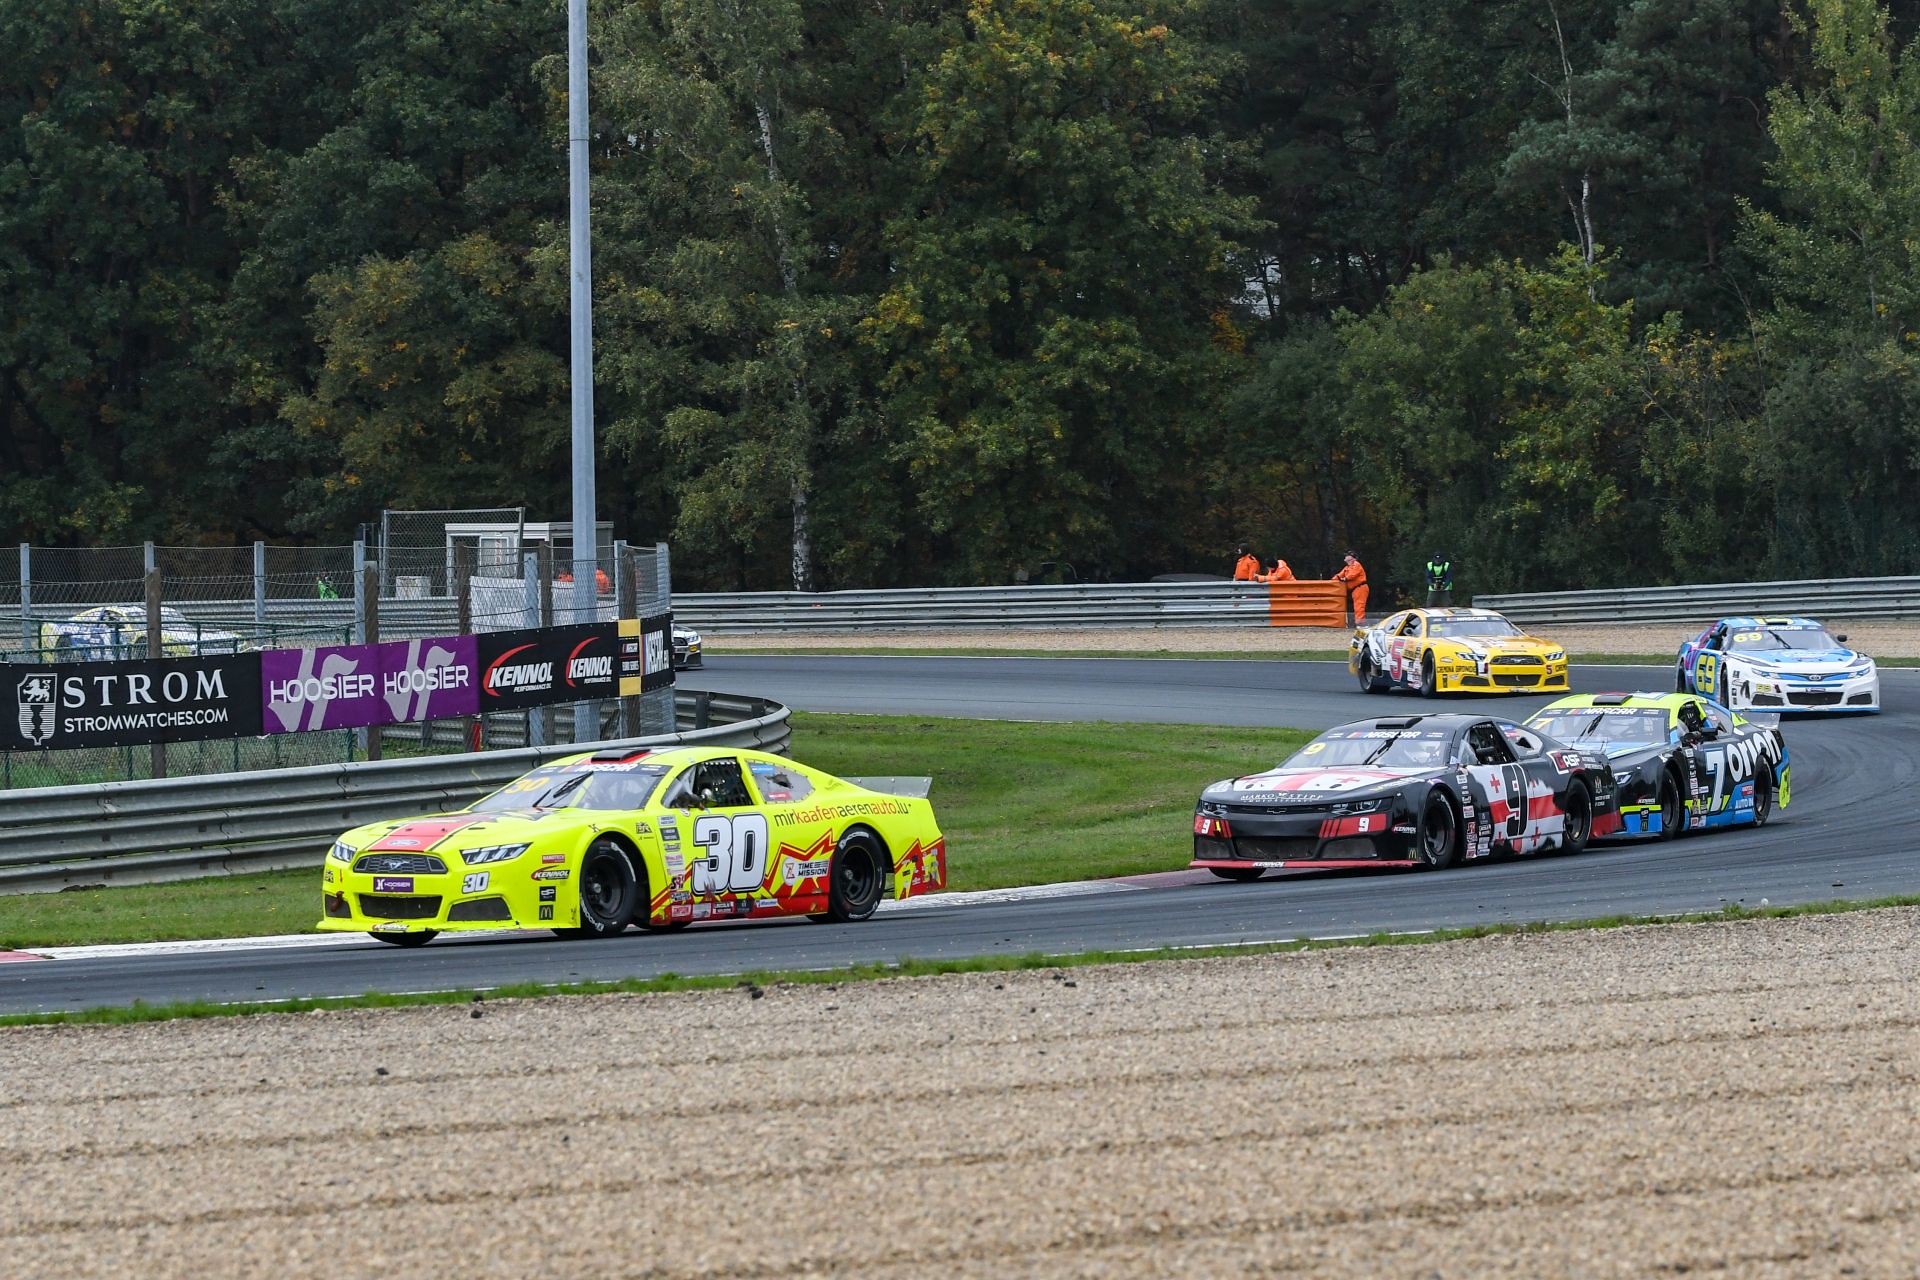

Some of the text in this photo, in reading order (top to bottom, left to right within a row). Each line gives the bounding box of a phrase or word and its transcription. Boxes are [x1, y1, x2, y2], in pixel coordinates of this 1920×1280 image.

[1733, 632, 1762, 642] 69
[567, 656, 612, 678] KENNOL
[1391, 638, 1405, 682] 5
[1546, 665, 1552, 674] 5
[384, 665, 469, 695] HOOSIER
[488, 662, 553, 688] KENNOL
[1696, 654, 1716, 694] 69
[63, 669, 228, 708] STROM
[270, 674, 375, 703] HOOSIER
[514, 684, 543, 693] PERFORMANCE
[64, 708, 228, 733] STROMWATCHES.COM
[1583, 707, 1638, 715] NASCAR
[1364, 731, 1421, 739] NASCAR
[1727, 729, 1782, 782] orion
[575, 763, 638, 772] NASCAR
[504, 777, 550, 793] 30
[1705, 748, 1726, 811] 7
[1500, 763, 1529, 839] 9
[774, 800, 909, 827] mirkaafenaerenauto.lu
[1358, 817, 1369, 832] 9
[1202, 819, 1210, 834] 9
[692, 812, 768, 896] 30
[462, 871, 489, 894] 30
[534, 870, 569, 878] KENNOL
[797, 868, 827, 876] MISSION
